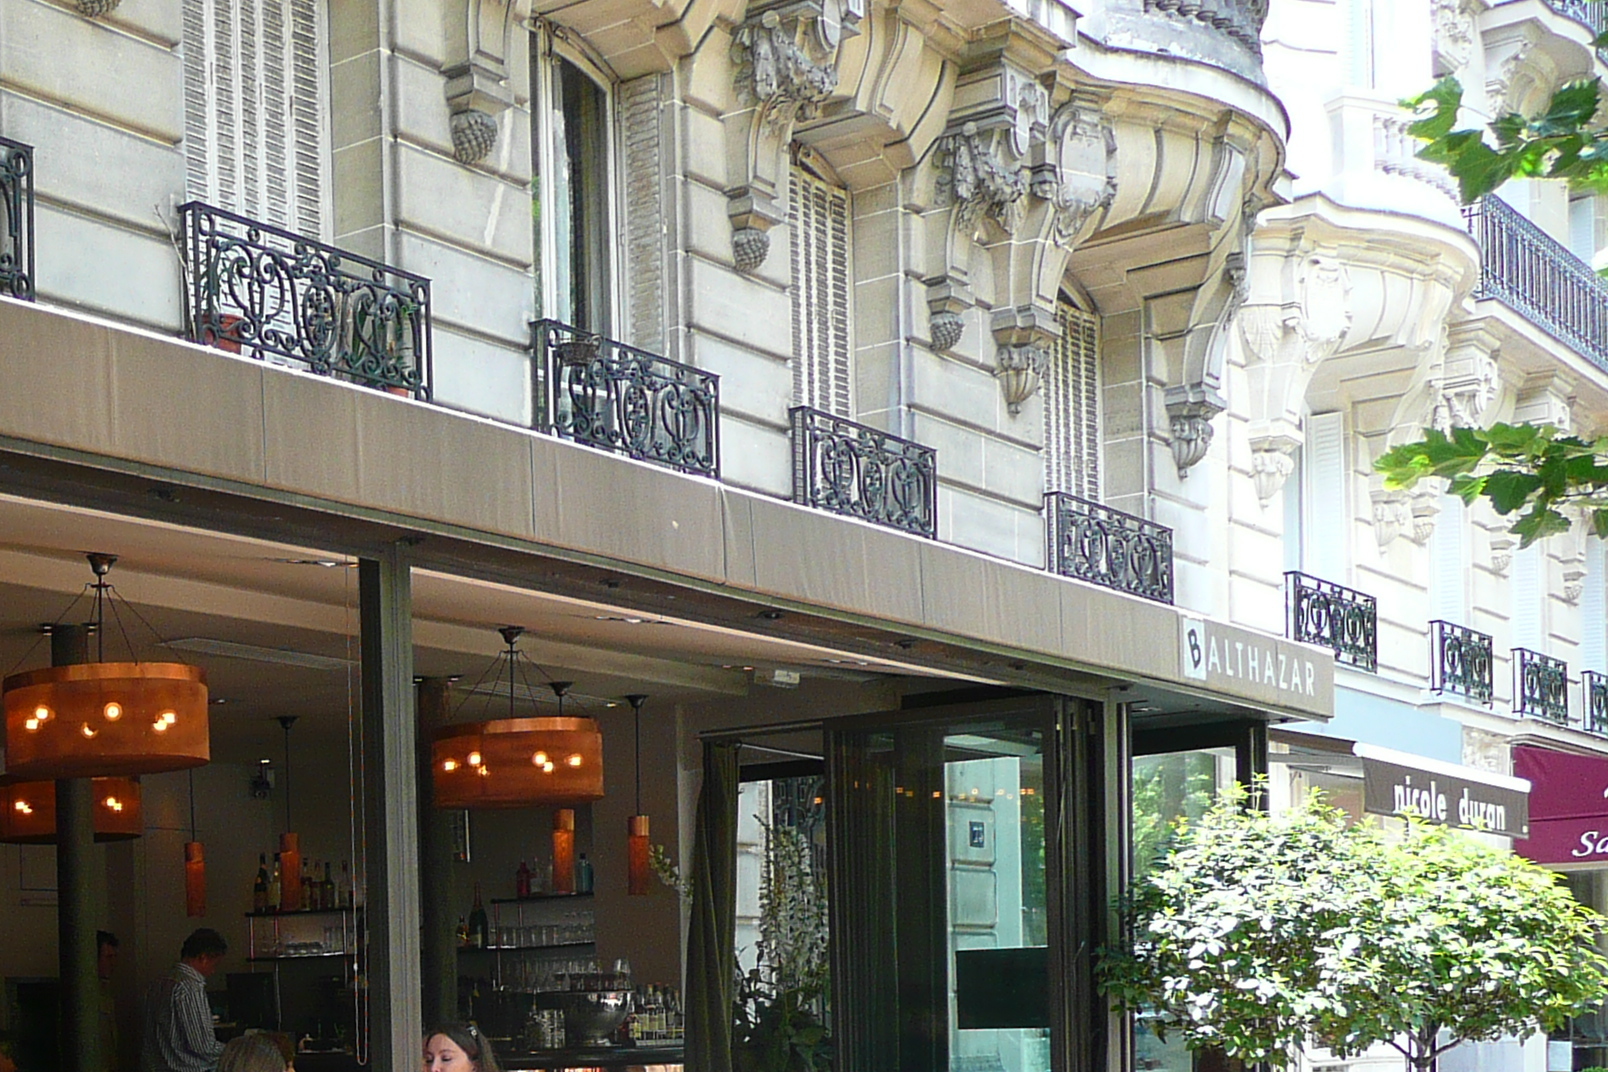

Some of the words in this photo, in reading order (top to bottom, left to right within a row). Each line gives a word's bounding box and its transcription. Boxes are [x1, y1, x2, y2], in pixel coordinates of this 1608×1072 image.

[1188, 628, 1314, 696] BALTHAZAR
[1394, 775, 1447, 820] nicole
[1459, 788, 1506, 830] duran
